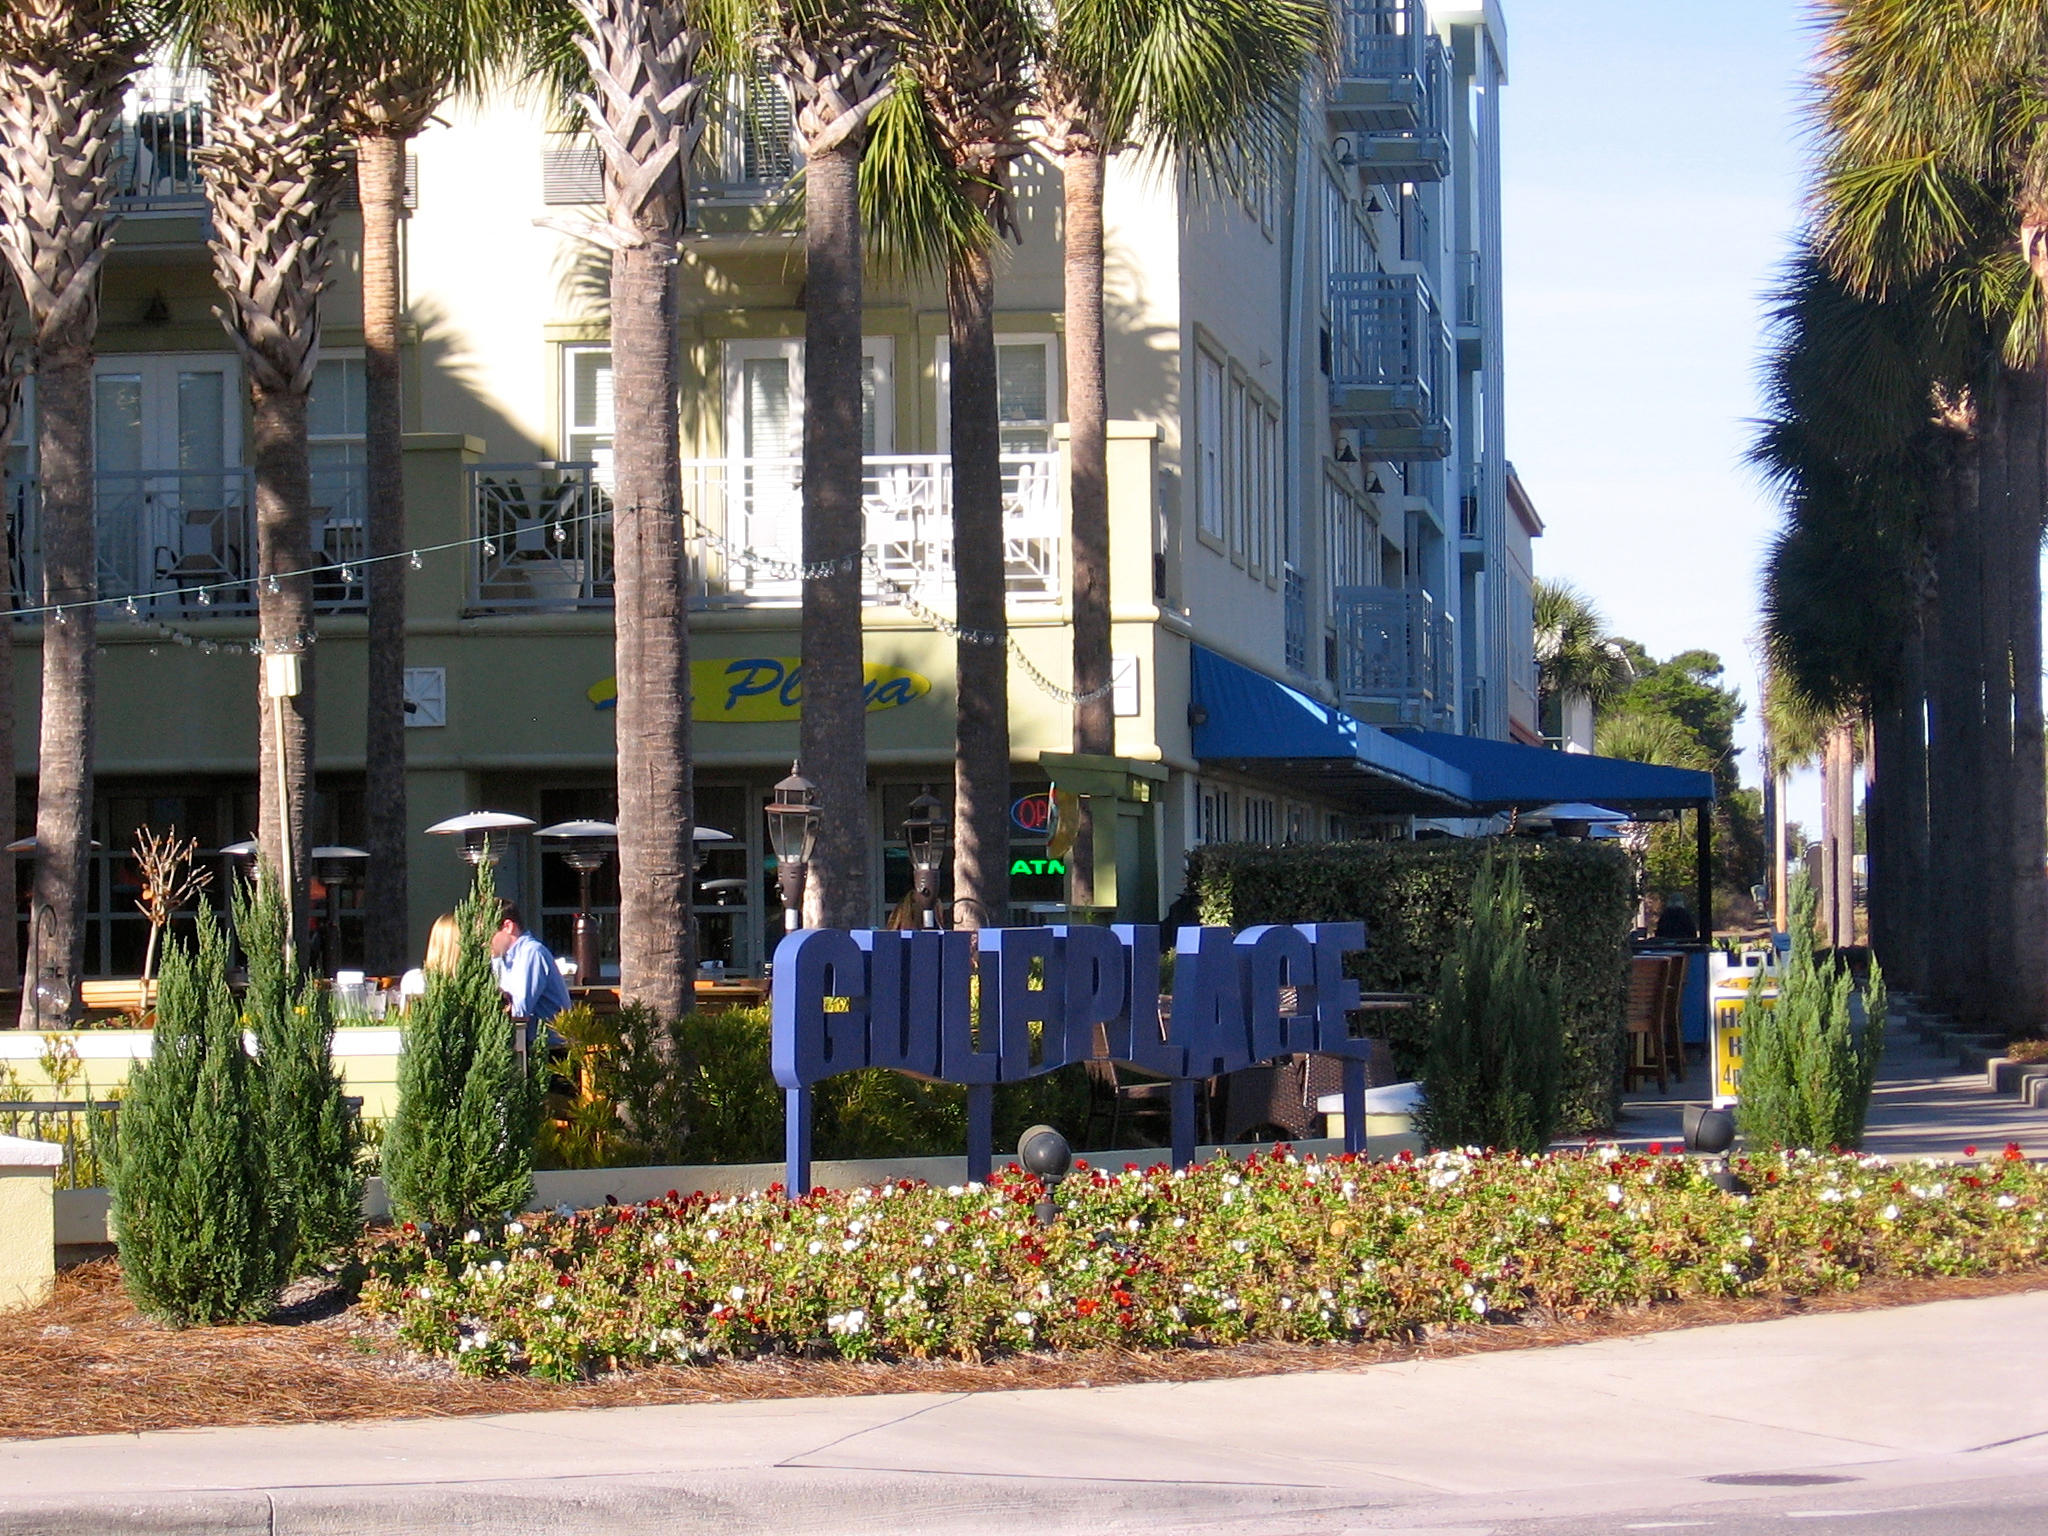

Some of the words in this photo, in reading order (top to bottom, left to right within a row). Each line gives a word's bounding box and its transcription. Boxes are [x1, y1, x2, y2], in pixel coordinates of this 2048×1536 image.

[724, 658, 919, 710] Pla
[1019, 799, 1048, 828] OP
[772, 927, 1056, 1088] GULF
[1064, 921, 1373, 1081] PLACE
